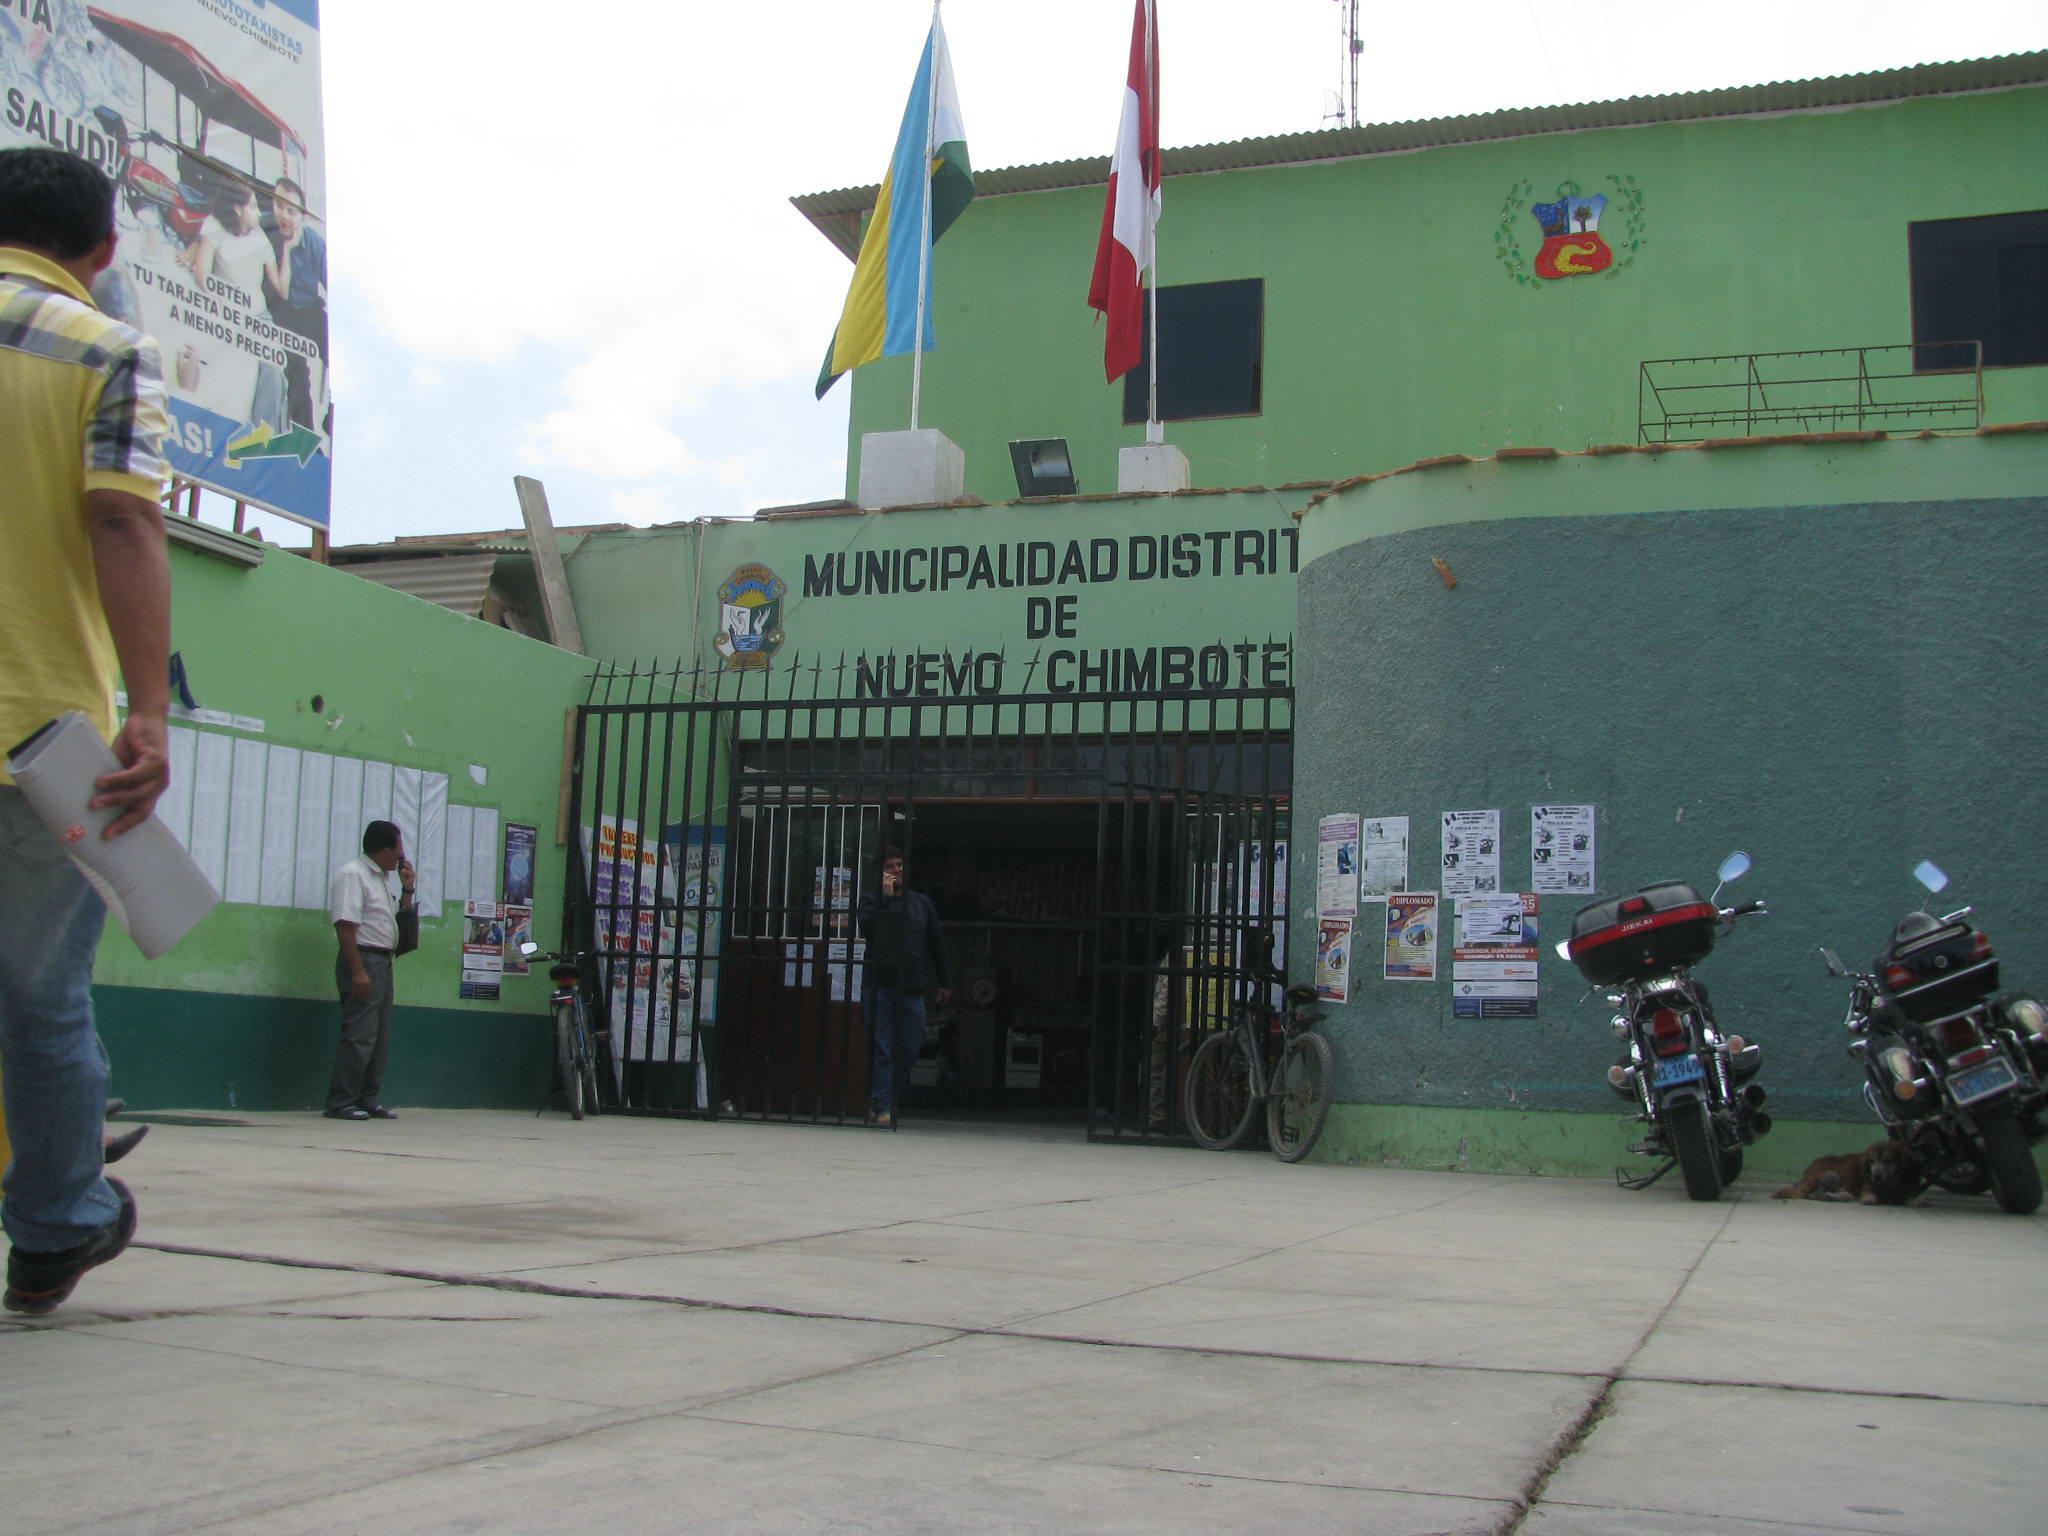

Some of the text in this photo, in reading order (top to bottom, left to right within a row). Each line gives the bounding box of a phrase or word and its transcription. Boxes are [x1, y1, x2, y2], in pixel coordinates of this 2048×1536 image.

[240, 24, 301, 64] CHIMBOTE
[6, 87, 117, 179] SALUD!
[133, 264, 317, 358] TU TARJETA DE PROPIEDAD
[206, 276, 251, 308] OBTÉN
[170, 305, 285, 366] A MENOS PRECIO
[803, 537, 1118, 597] MUNICIPALIDAD
[1027, 596, 1077, 639] DE
[856, 645, 1288, 698] NUEVO CHIMBOTE
[1396, 897, 1433, 905] DIPLOMADO
[1522, 899, 1535, 910] 25
[1621, 918, 1653, 932] JIEKAI
